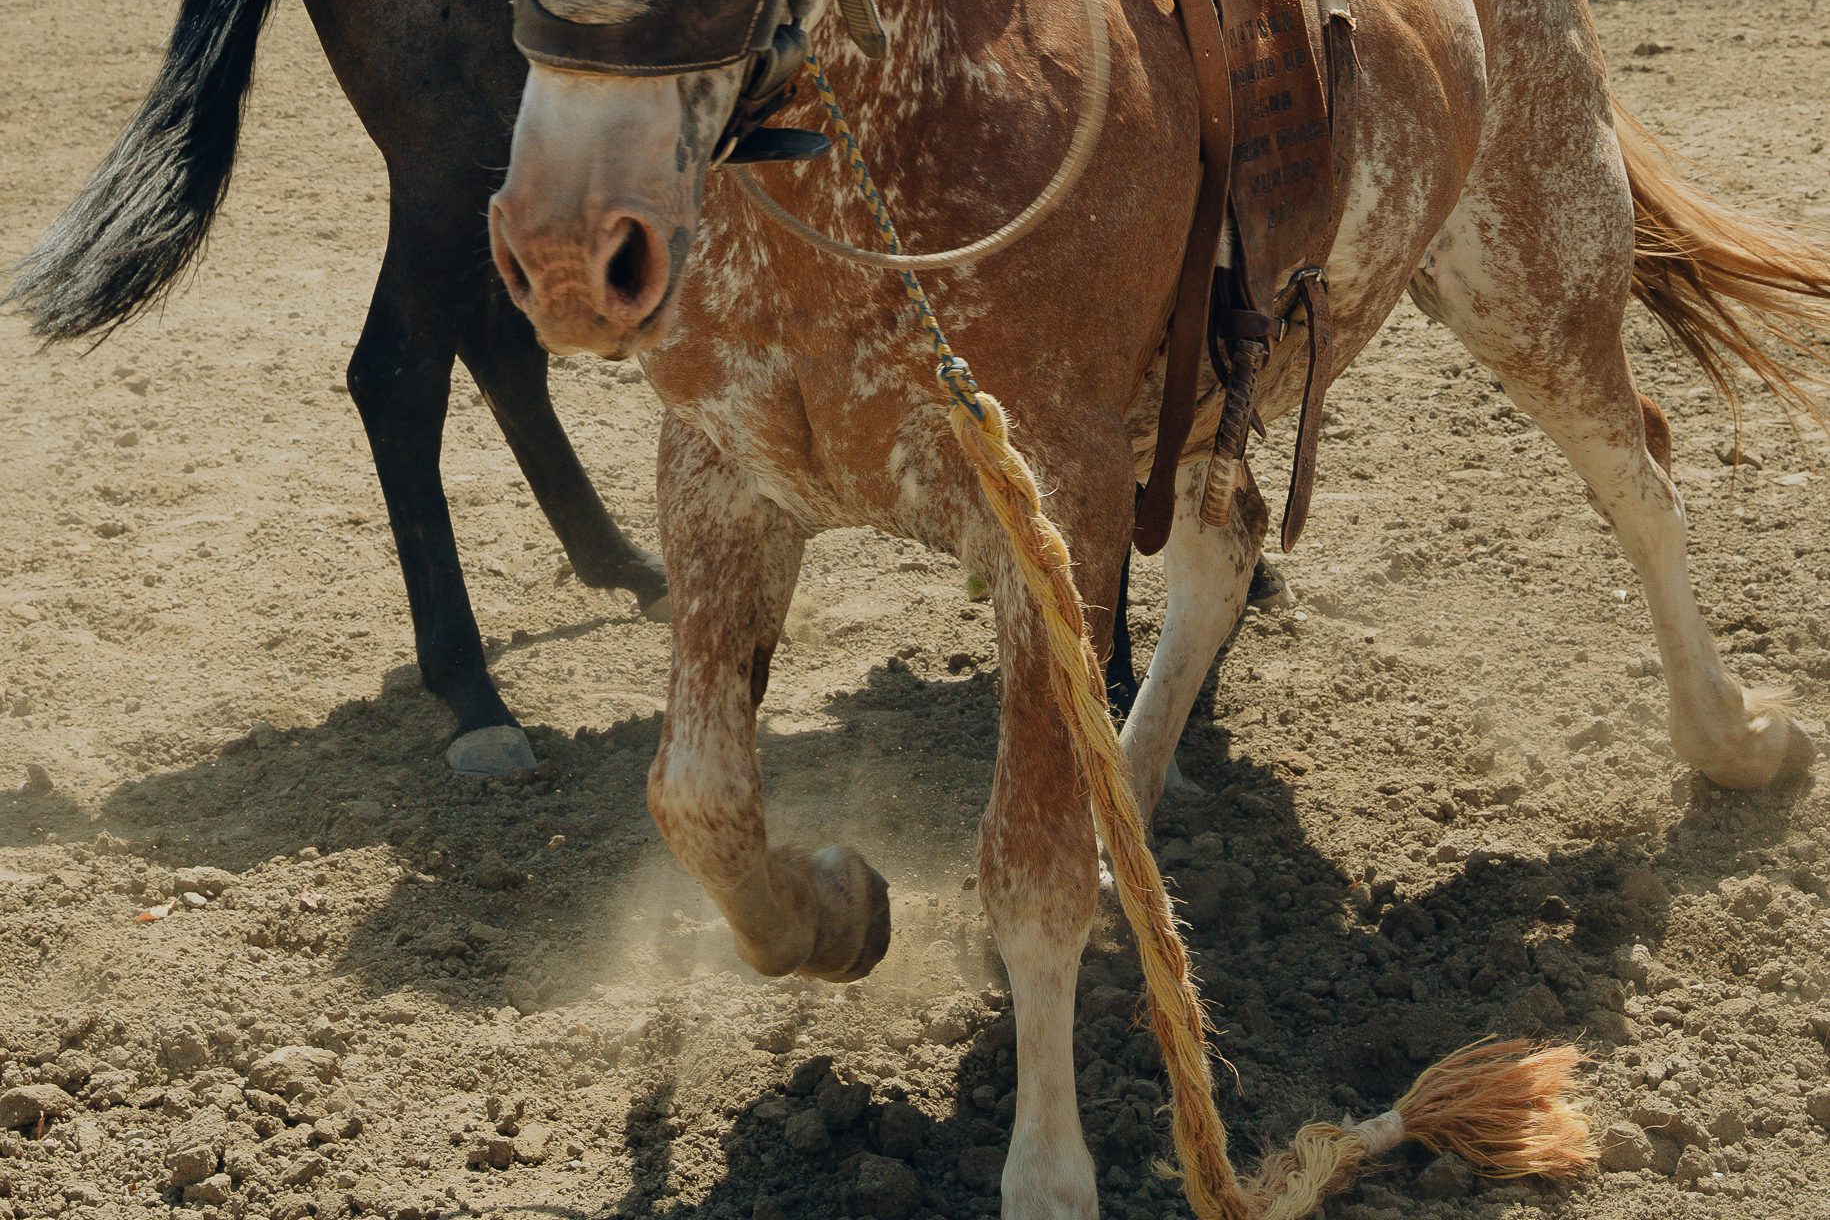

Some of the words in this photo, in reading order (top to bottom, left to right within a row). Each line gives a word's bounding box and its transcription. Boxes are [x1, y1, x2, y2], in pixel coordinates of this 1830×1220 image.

[1231, 57, 1275, 91] ROUND
[1283, 48, 1307, 72] UP
[1251, 91, 1292, 120] CLUB
